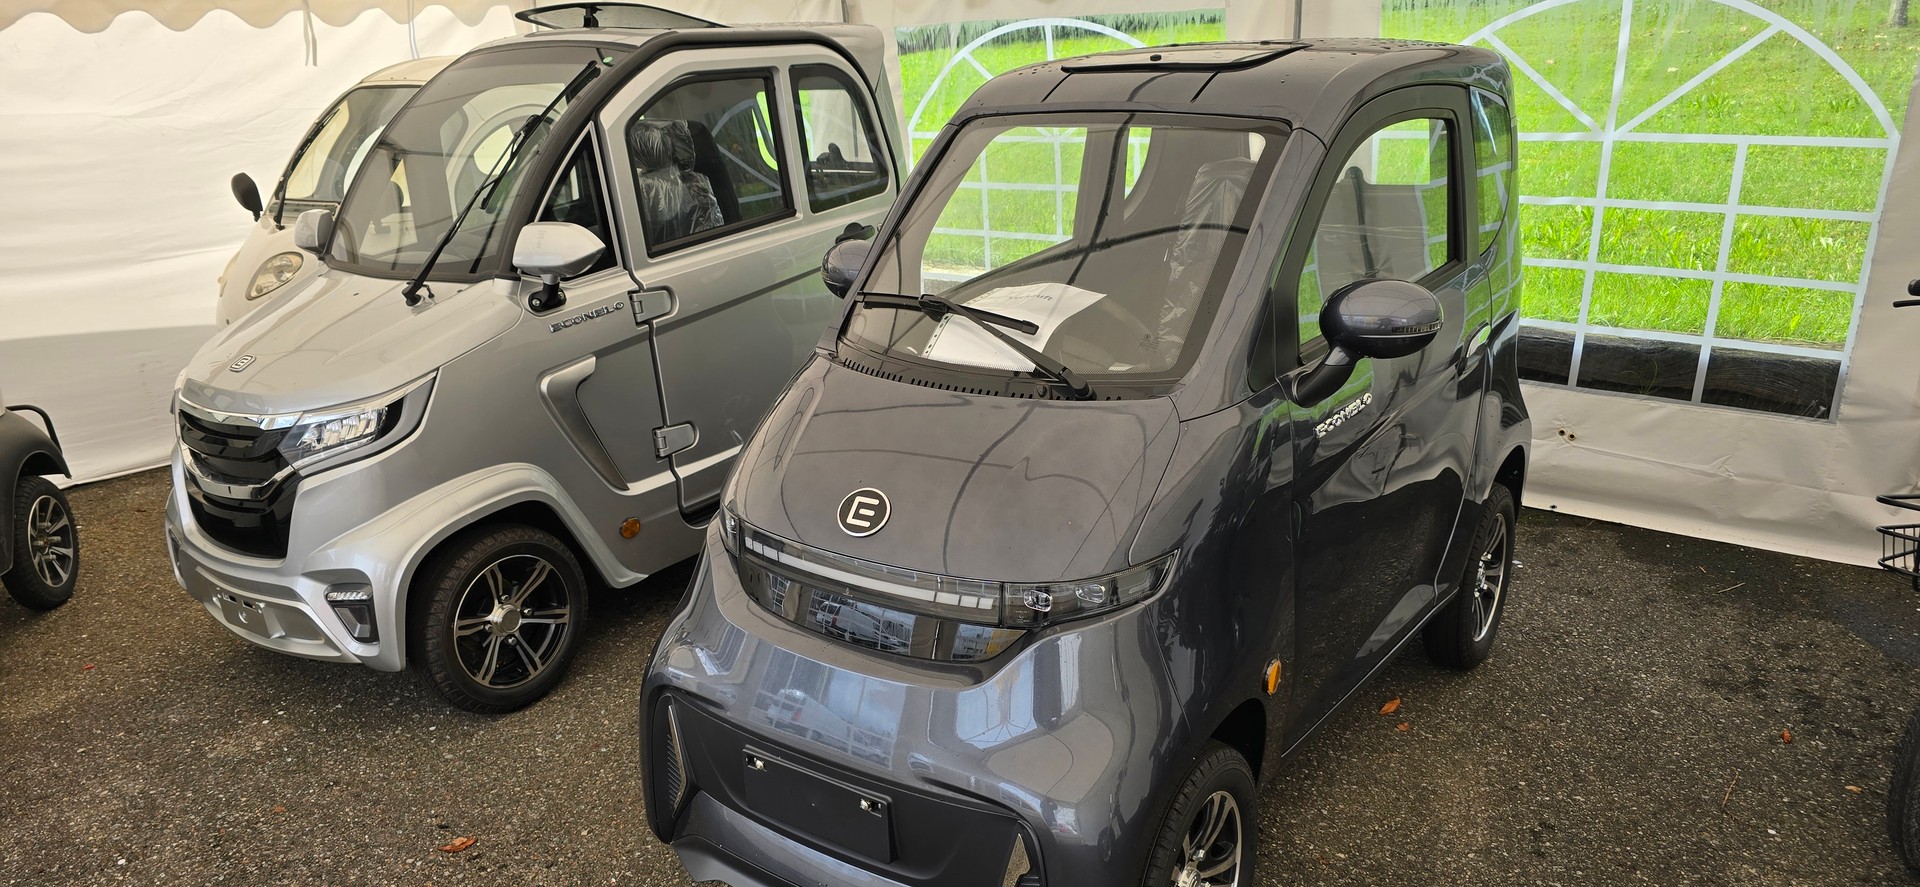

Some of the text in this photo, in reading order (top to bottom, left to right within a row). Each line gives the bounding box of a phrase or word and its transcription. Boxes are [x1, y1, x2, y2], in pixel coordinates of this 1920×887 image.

[549, 301, 624, 333] ECONELO
[1313, 393, 1373, 438] ECONELO
[846, 495, 880, 528] E
